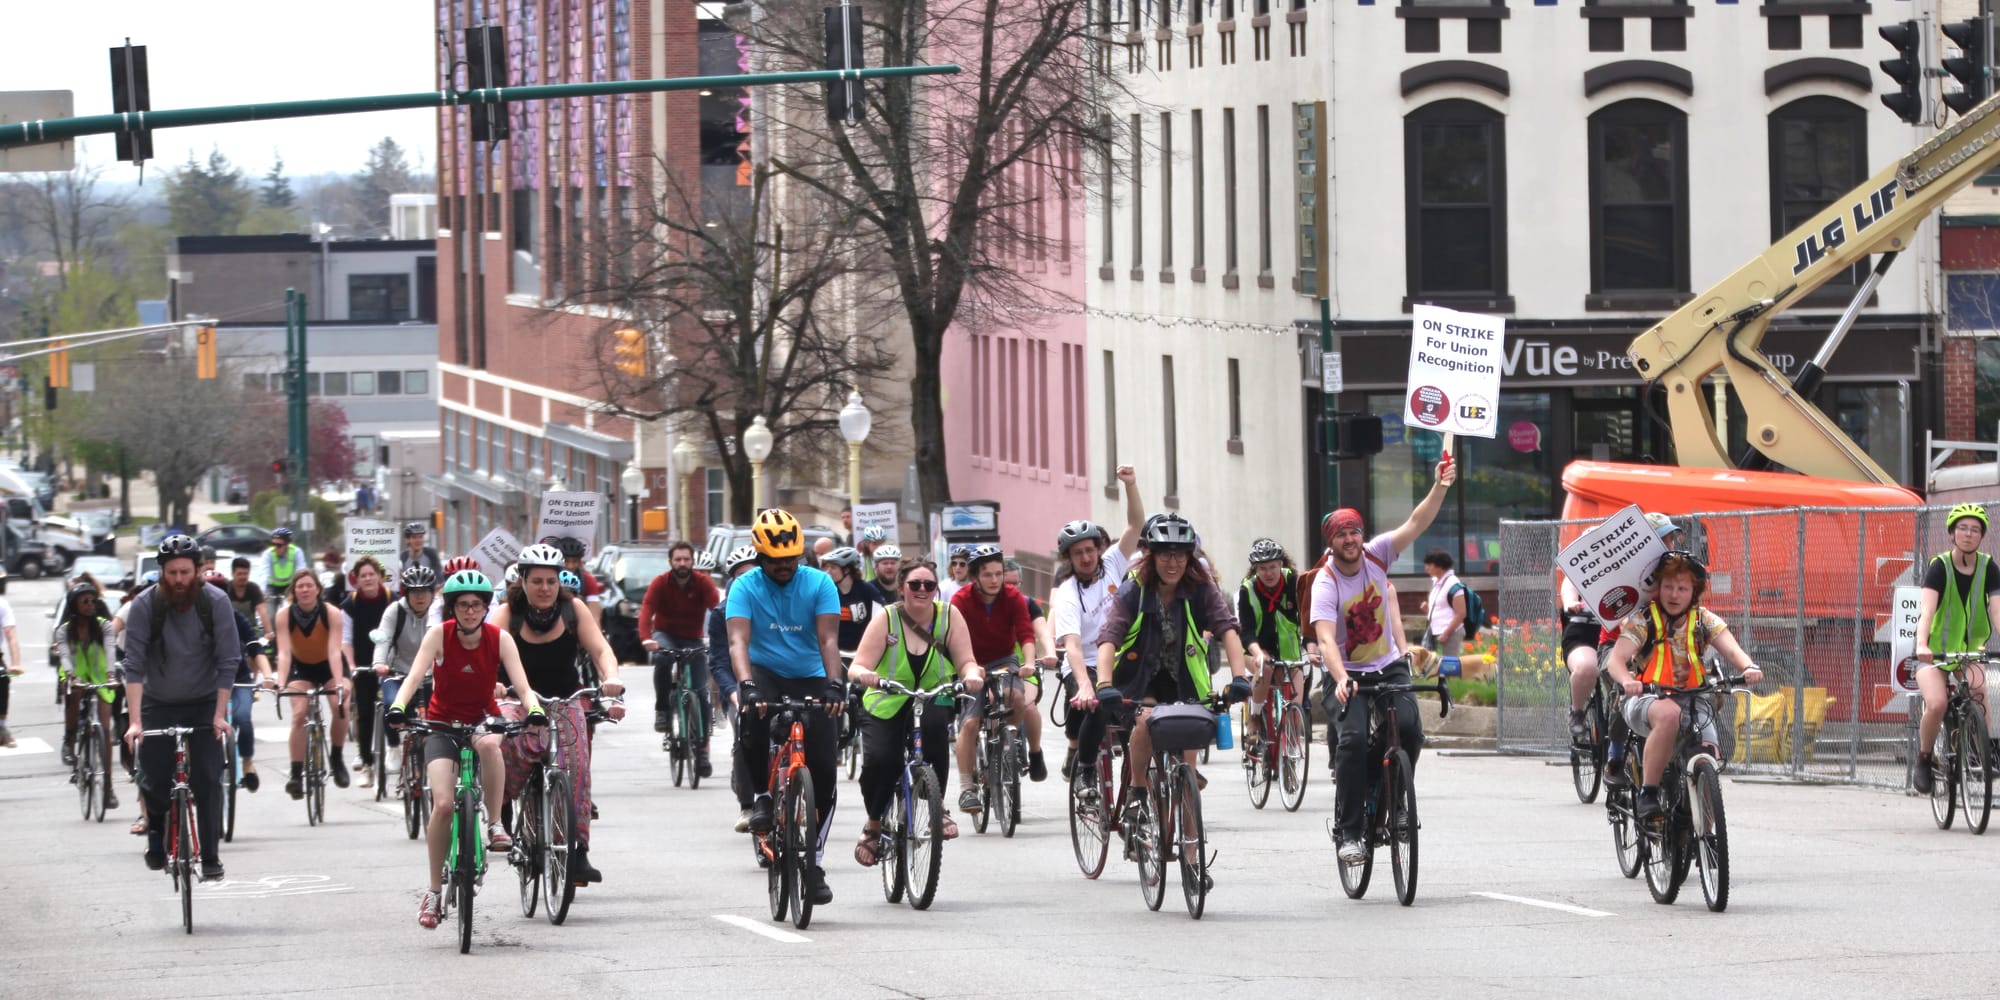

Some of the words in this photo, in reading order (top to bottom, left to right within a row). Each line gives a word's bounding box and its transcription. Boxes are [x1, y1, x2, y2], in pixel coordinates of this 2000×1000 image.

[1793, 217, 1846, 276] JLG
[1852, 179, 1903, 233] LIF
[1423, 320, 1442, 332] ON
[1446, 324, 1495, 341] STRIKE
[1426, 337, 1447, 350] For
[1450, 342, 1488, 356] Union
[1417, 352, 1494, 374] Recognition
[1583, 355, 1595, 367] by
[563, 500, 596, 508] STRIKE
[543, 519, 593, 527] Recognition
[1569, 550, 1589, 567] ON
[1590, 516, 1636, 553] STRIKE
[1580, 558, 1601, 574] For
[1603, 531, 1639, 559] Union
[1581, 534, 1652, 590] Recognition
[1901, 600, 1917, 609] ON
